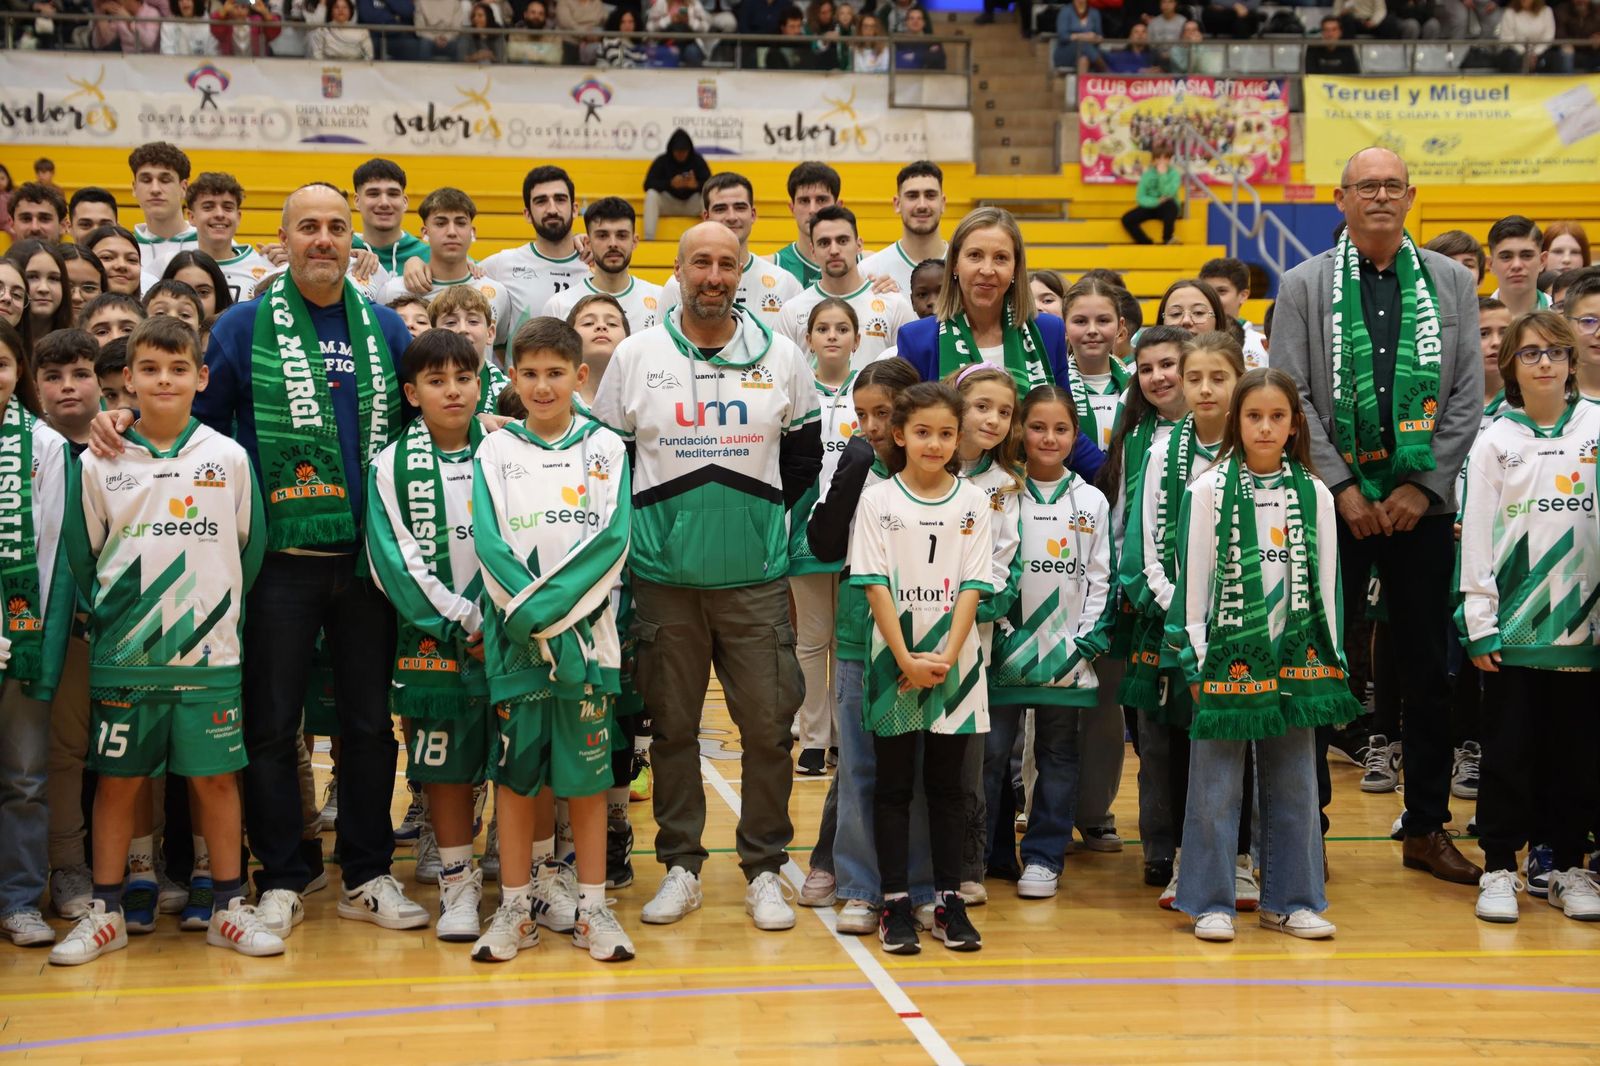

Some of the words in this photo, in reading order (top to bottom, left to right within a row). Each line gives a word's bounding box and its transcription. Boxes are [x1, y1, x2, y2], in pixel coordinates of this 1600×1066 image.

[1087, 79, 1127, 96] CLUB
[1130, 79, 1212, 97] GIMNASIA
[1323, 84, 1399, 101] Teruel
[1409, 87, 1421, 105] y
[1430, 84, 1511, 105] Miguel
[295, 104, 369, 116] DIPUTACIÓN
[393, 101, 502, 140] sabores
[1376, 109, 1392, 119] DE
[297, 116, 313, 127] DE
[763, 110, 867, 147] sabores
[277, 333, 324, 430] MURGI
[659, 435, 718, 447] Fundación
[675, 448, 750, 459] Mediterránea
[193, 461, 227, 482] BALONCESTO
[269, 443, 345, 491] BALONCESTO
[276, 485, 343, 501] MURGI
[121, 515, 219, 539] surseeds
[928, 533, 938, 564] 1
[1204, 643, 1277, 680] BALONCESTO
[1210, 681, 1275, 693] MURGI
[97, 720, 131, 759] 15
[413, 728, 449, 767] 18
